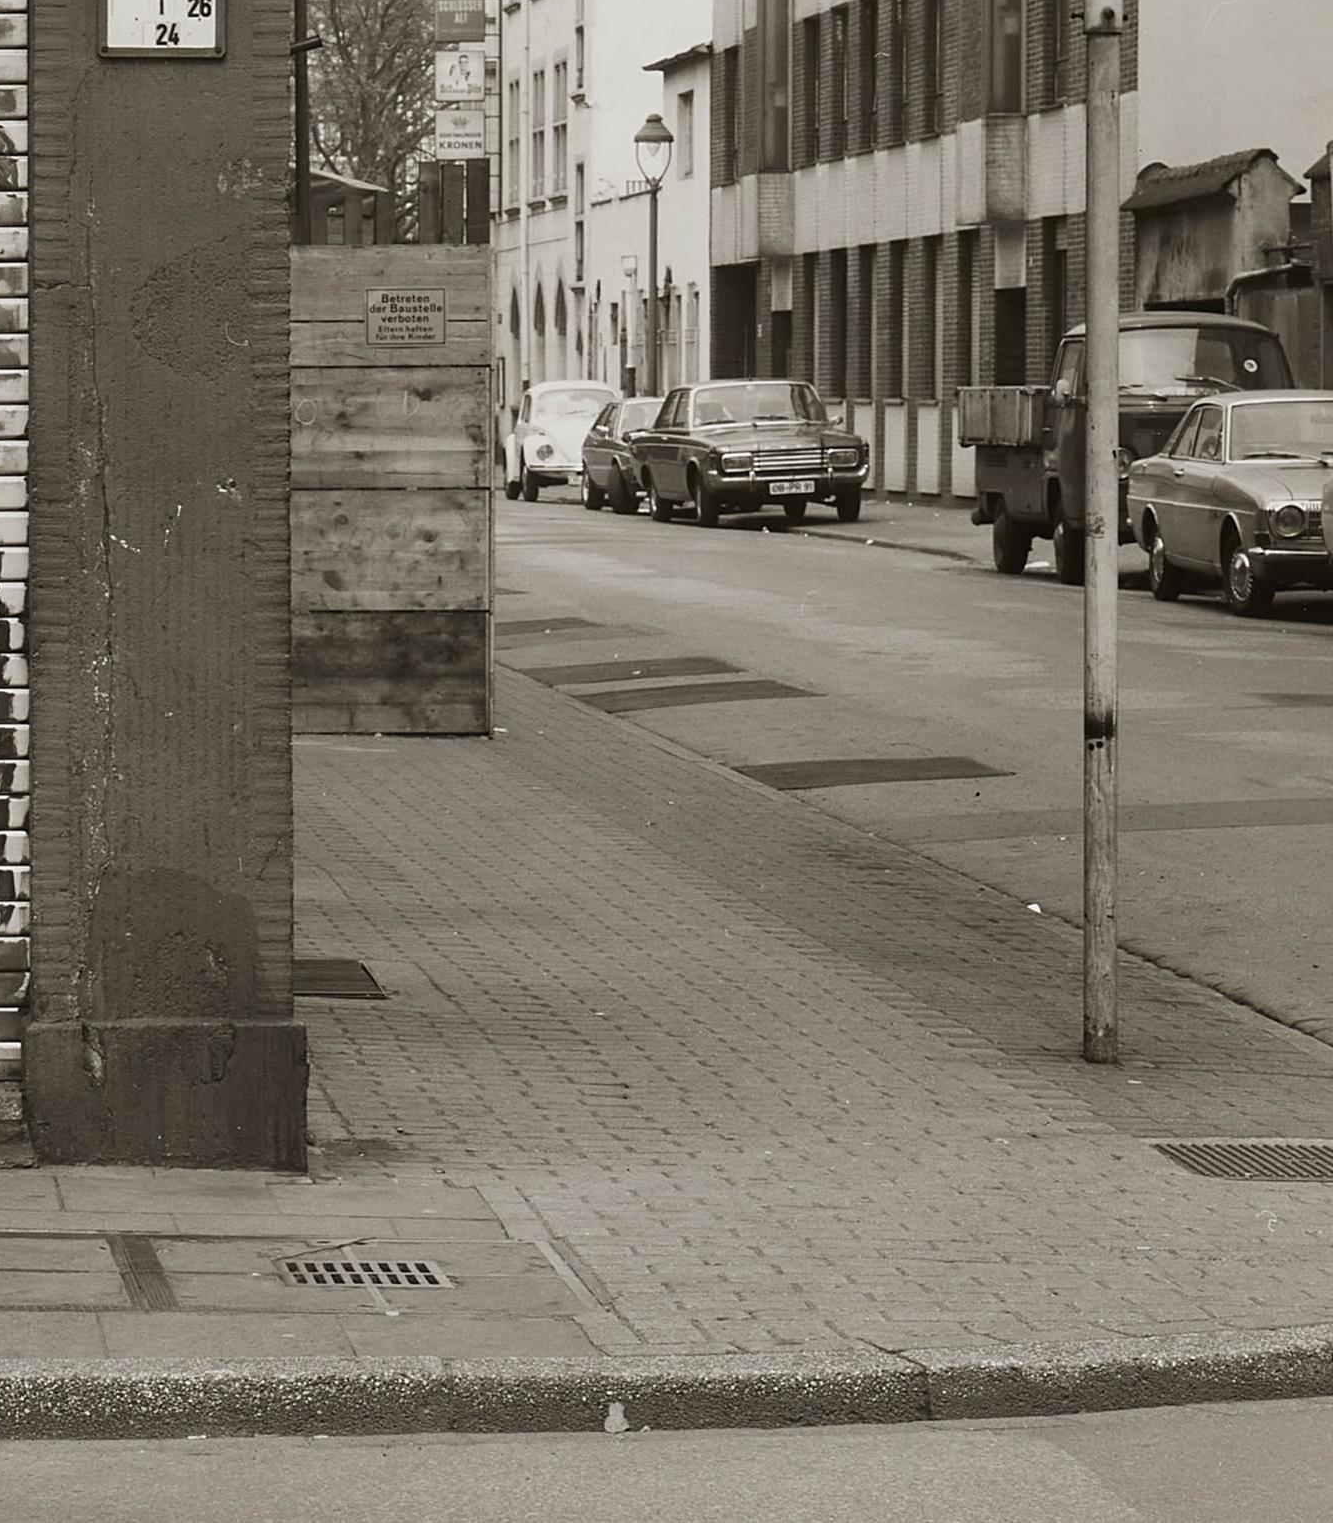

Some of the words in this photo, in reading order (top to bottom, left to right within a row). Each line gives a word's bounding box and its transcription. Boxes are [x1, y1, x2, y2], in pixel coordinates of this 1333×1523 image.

[156, 23, 180, 45] 24
[439, 141, 483, 149] KRONEN
[381, 293, 430, 303] Betreten
[369, 304, 386, 314] der
[390, 303, 443, 313] Baustelle
[381, 314, 430, 324] verboten
